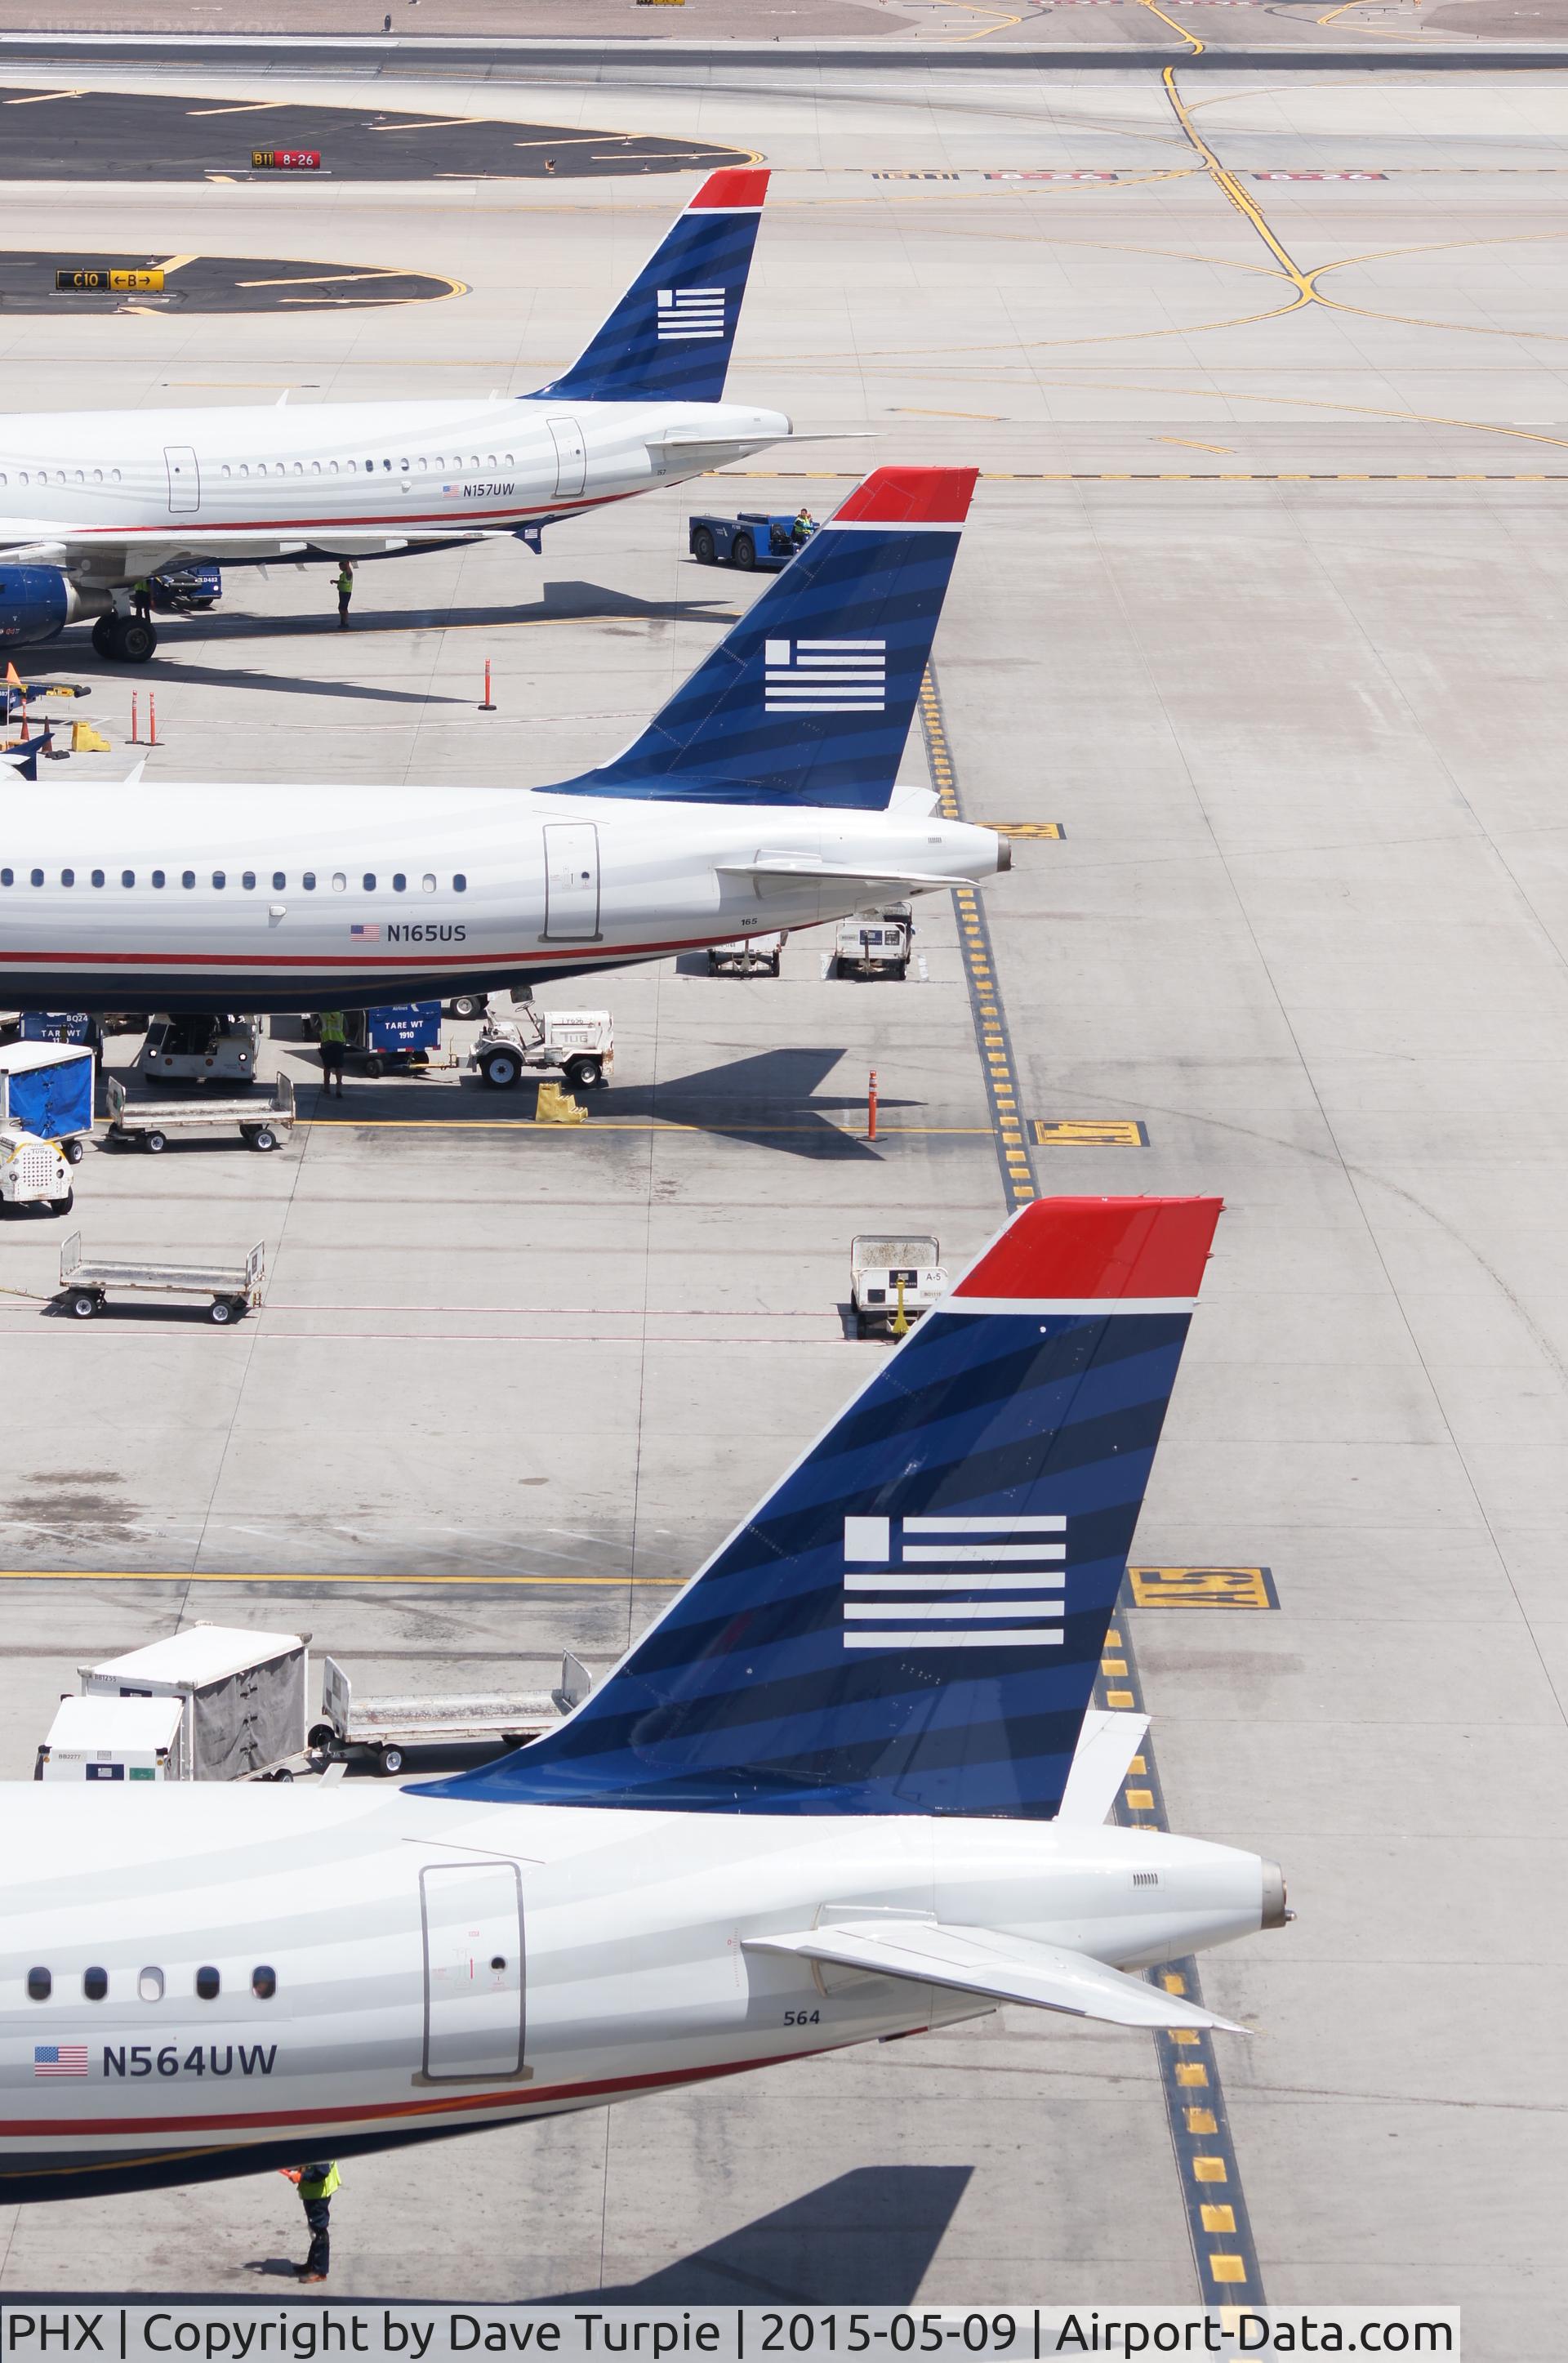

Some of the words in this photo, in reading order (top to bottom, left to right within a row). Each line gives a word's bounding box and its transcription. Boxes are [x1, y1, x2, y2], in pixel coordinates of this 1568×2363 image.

[254, 154, 272, 165] B11
[283, 154, 314, 165] 8-26
[74, 273, 98, 287] C10
[127, 274, 136, 287] B
[463, 483, 514, 497] N157UW
[741, 917, 758, 926] 165
[388, 925, 466, 942] N165US
[66, 1014, 88, 1023] BQ24
[385, 1021, 407, 1030] TARE
[411, 1020, 424, 1028] WT
[399, 1031, 415, 1040] 1910
[926, 1273, 942, 1282] A-5
[1139, 1571, 1258, 1606] A5
[783, 2009, 821, 2026] 564
[104, 2044, 278, 2077] N564UW
